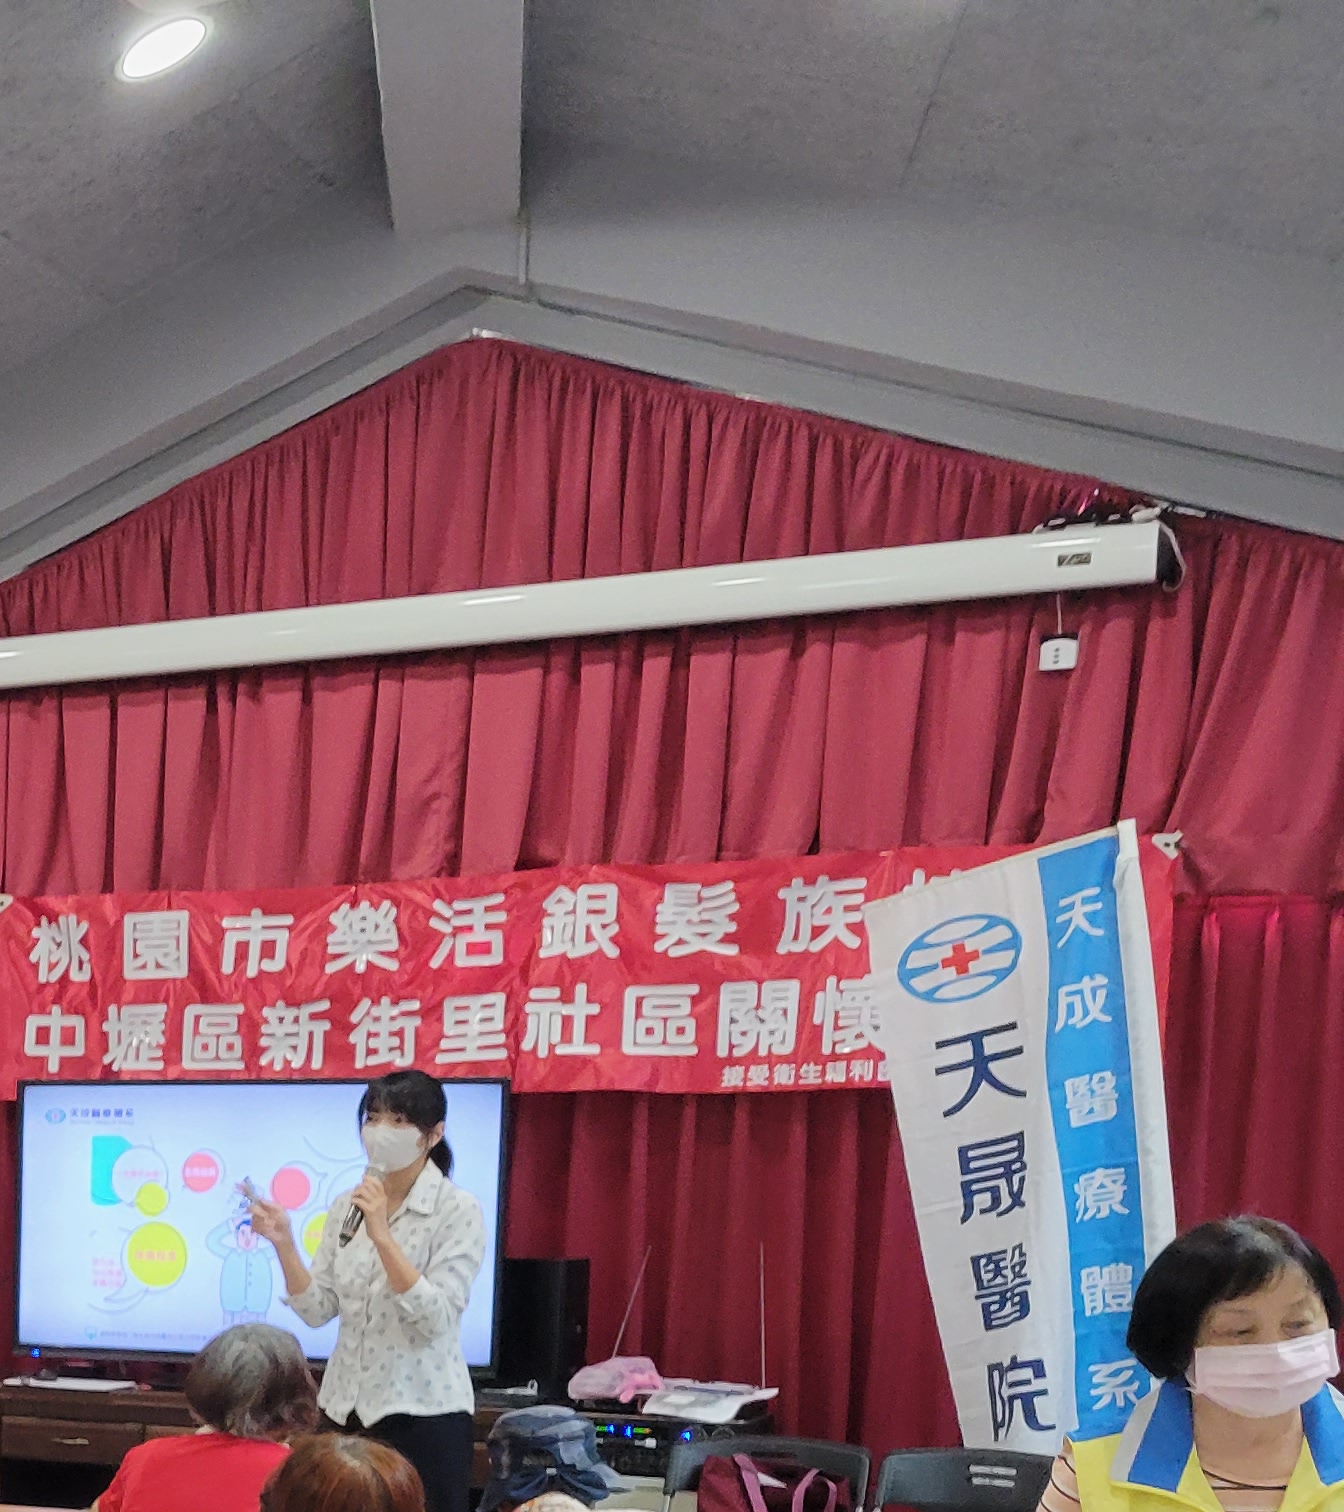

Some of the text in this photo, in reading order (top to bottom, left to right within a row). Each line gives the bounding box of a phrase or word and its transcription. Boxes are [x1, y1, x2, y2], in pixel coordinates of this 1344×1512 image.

[23, 974, 888, 1074] 中壢區新街里社區關懷
[28, 869, 964, 984] 桃園市樂活銀髮族
[934, 1020, 1057, 1443] 天晟醫院
[1054, 886, 1141, 1411] 天成醫療體系
